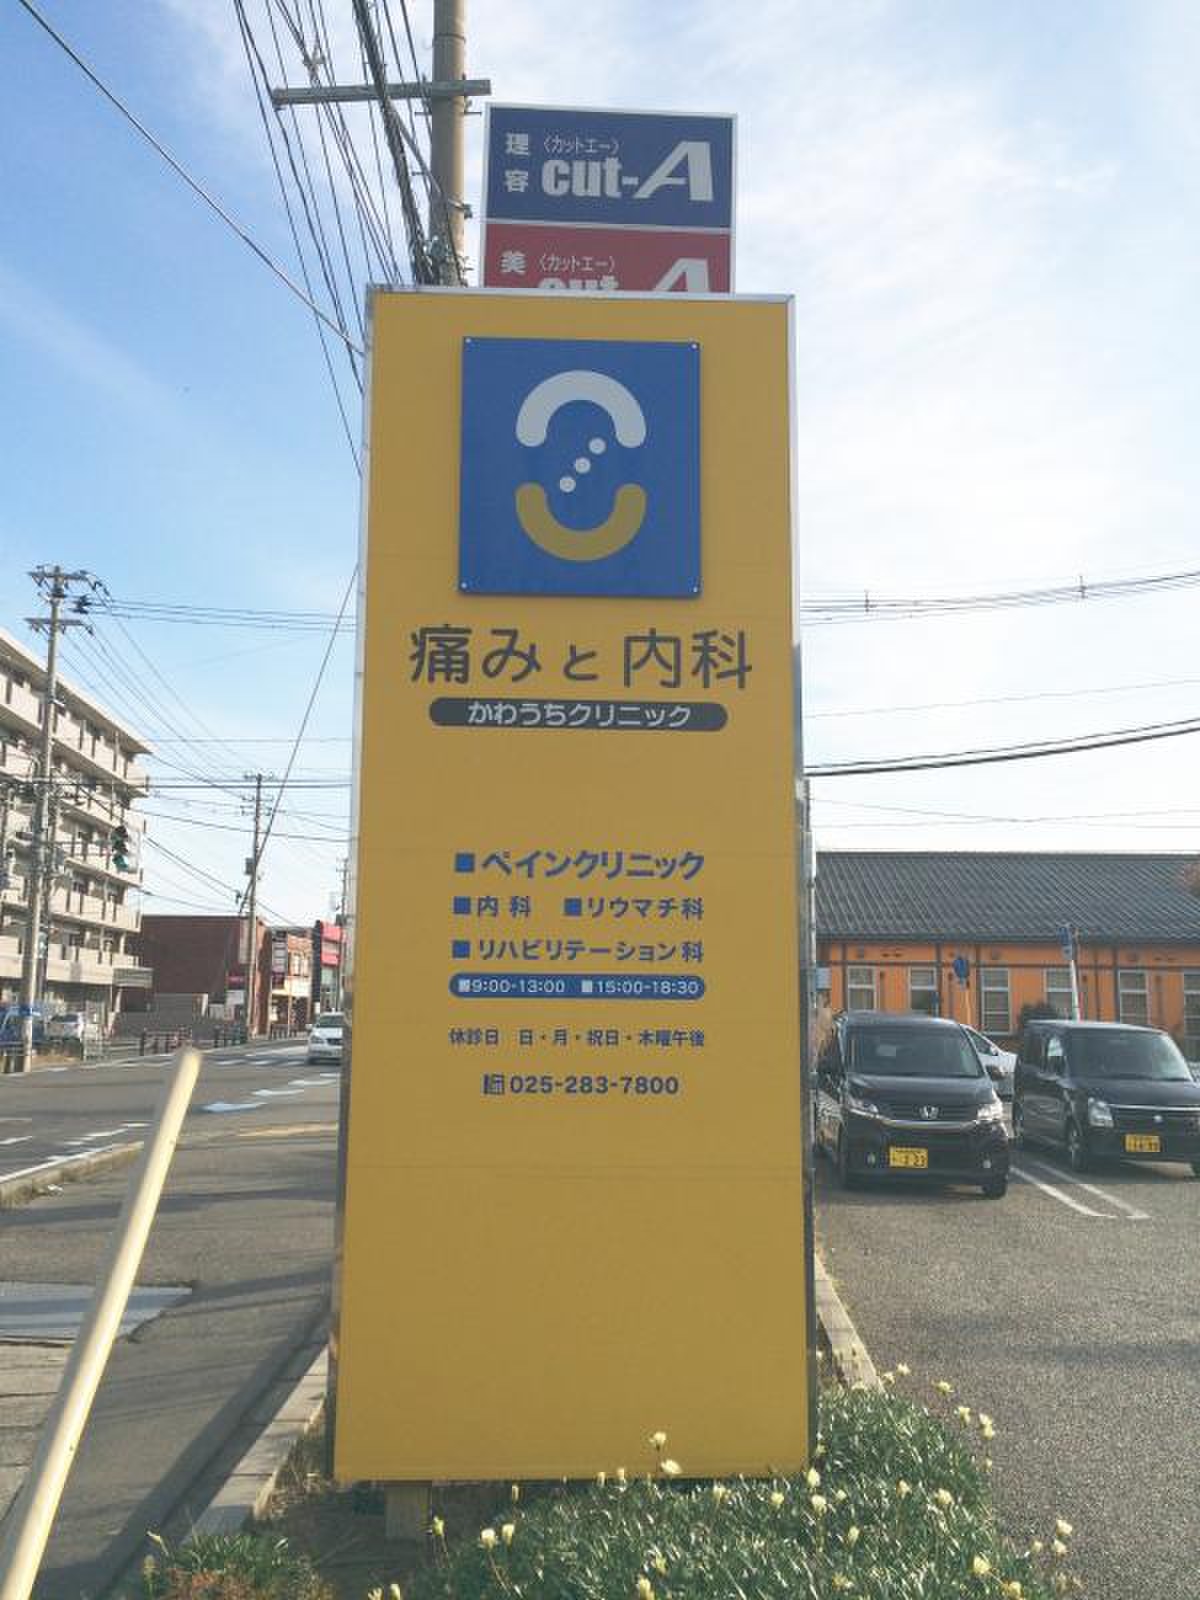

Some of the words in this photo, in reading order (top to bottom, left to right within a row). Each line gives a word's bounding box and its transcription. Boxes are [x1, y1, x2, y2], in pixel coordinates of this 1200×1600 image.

[541, 140, 714, 202] cut-A
[409, 624, 753, 690] 痛みと内科
[467, 701, 692, 727] かわうちクリニック
[481, 850, 705, 880] ペインクリニック
[588, 897, 704, 918] リウマチ科
[479, 939, 704, 962] リハビリテーション科
[510, 1075, 679, 1095] 025-283-7800
